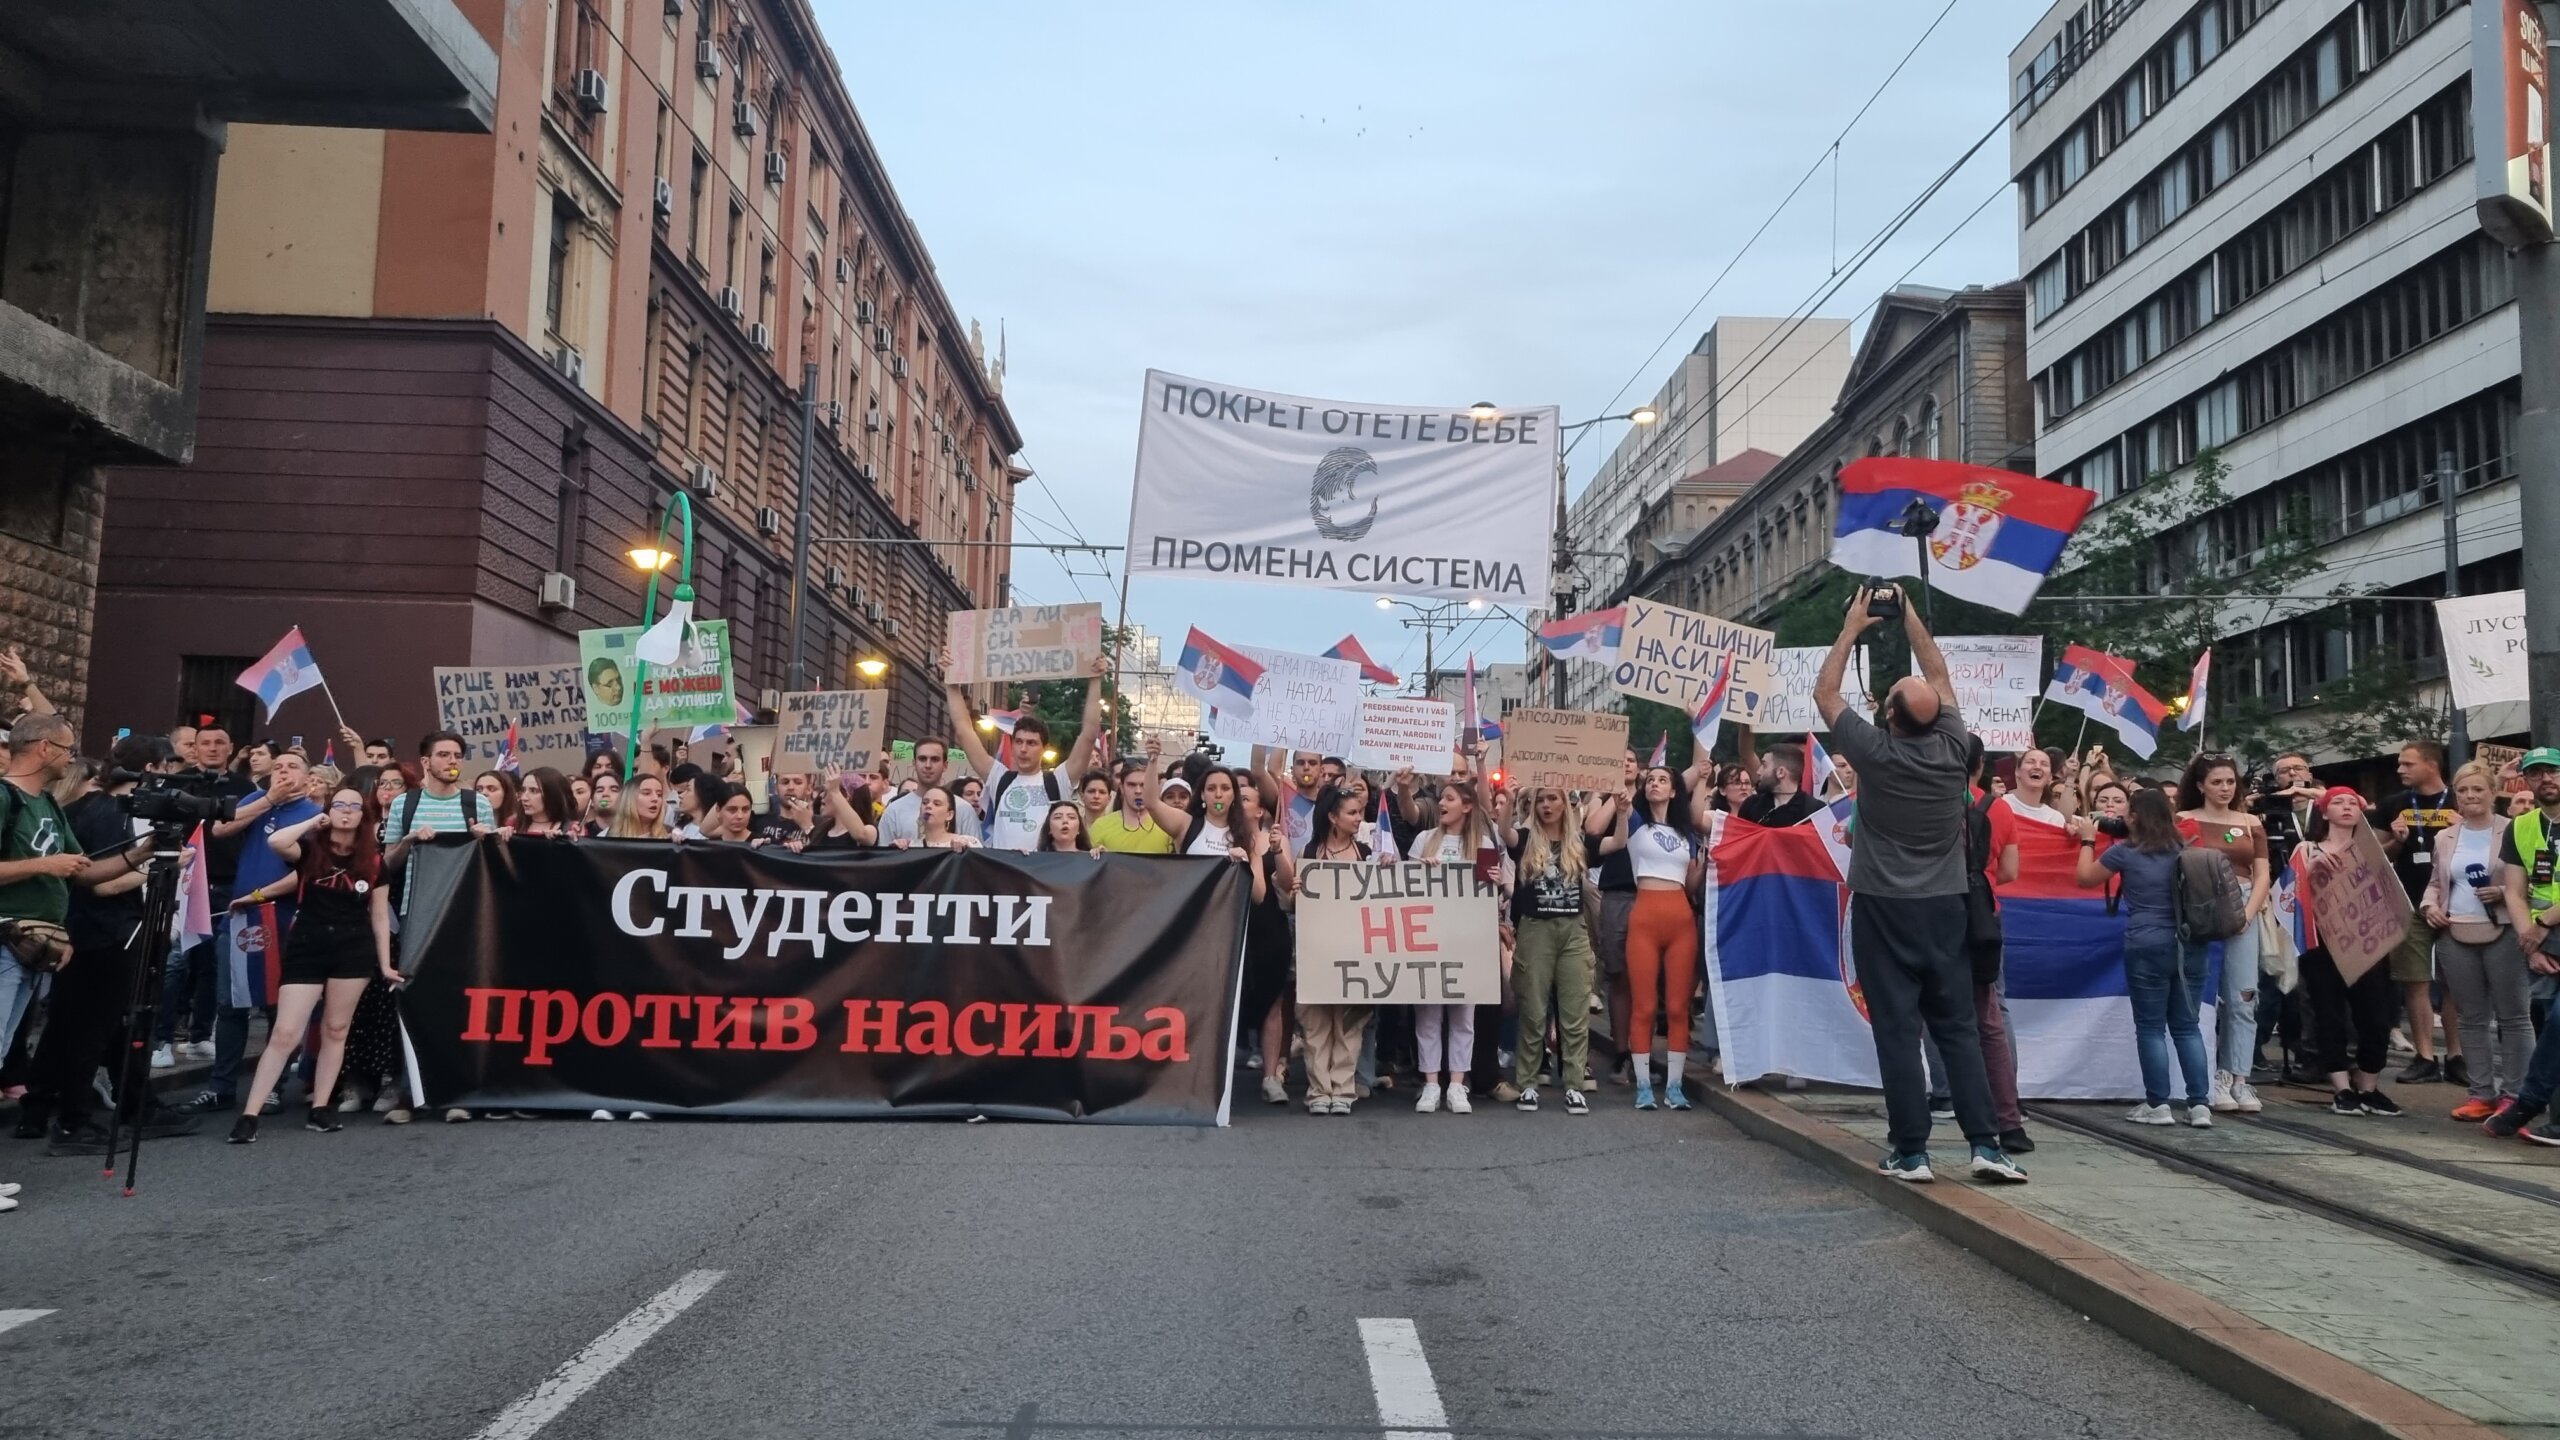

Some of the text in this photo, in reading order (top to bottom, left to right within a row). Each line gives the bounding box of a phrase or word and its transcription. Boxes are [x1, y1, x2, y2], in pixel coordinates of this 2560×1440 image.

[1162, 383, 1539, 445] ПОКРЕТ ОТЕТЕ БЕБЕ
[1151, 535, 1527, 596] ПРОМЕНА СИСТЕМА
[988, 605, 1061, 629] ДА ЛИ
[987, 631, 1013, 650] СИ
[1631, 604, 1772, 664] У ТИШИНИ
[986, 649, 1075, 678] РАЗУМЕО
[1268, 655, 1299, 676] НЕМА
[1303, 660, 1349, 685] ПРАВДЕ
[439, 671, 494, 696] КРШЕ
[506, 671, 540, 688] НАМ
[659, 675, 723, 694] МОЖЕШ
[1254, 676, 1272, 697] ЗА
[1949, 662, 2025, 690] РБИЈИ СЕ
[507, 690, 530, 710] ИЗ
[1615, 661, 1759, 718] ОПСТАЕ!
[645, 692, 724, 712] ДА КУПИШ?
[788, 692, 865, 712] ЖИВОТИ
[1363, 702, 1414, 714] PREDSEDNIČE
[1431, 706, 1448, 716] VAŠI
[521, 709, 555, 728] НАМ
[595, 711, 618, 727] 100
[797, 709, 870, 732] ДЕЦЕ
[1267, 702, 1282, 722] НЕ
[1289, 704, 1326, 727] БУДЕ
[1363, 715, 1445, 728] LAŽNI PRIJATELJI STE
[1595, 716, 1628, 732] ВЛАСТ
[784, 732, 852, 753] НЕМАЈУ
[1222, 717, 1343, 752] МИРА ЗА ВЛАСТ
[1359, 739, 1446, 752] DRŽAVNI NEPRIJATELJI
[1365, 728, 1401, 738] PARAZITI,
[1403, 731, 1437, 740] NARODNI
[611, 868, 1053, 960] Студенти
[1361, 905, 1439, 954] НЕ
[1333, 960, 1465, 1000] ЋУТЕ
[460, 987, 1190, 1066] против насиља
